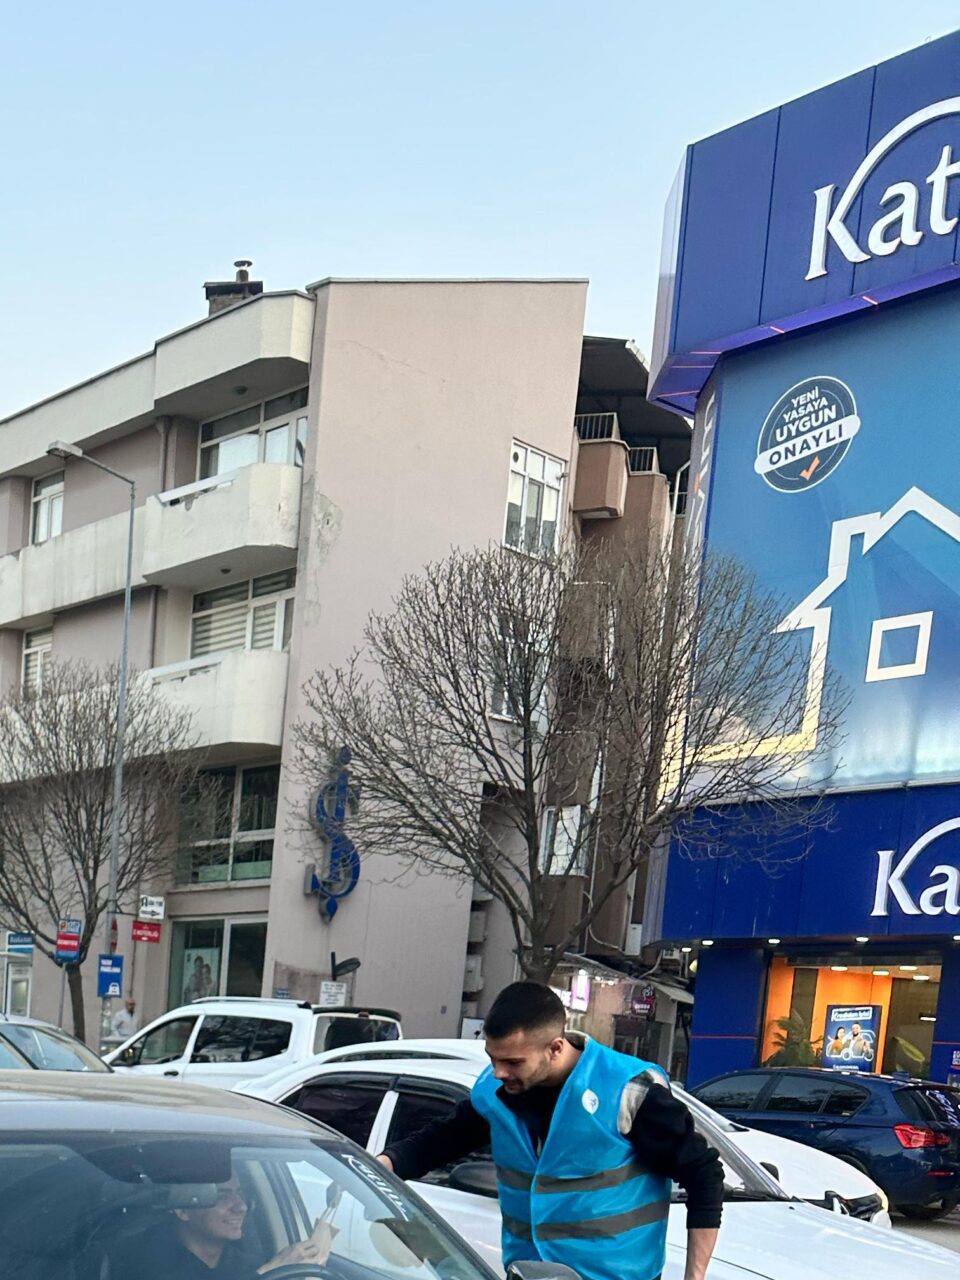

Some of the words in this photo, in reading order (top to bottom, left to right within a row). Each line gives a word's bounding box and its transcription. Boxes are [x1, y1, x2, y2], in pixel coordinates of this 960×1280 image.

[783, 397, 828, 422] YASAYA
[791, 386, 819, 408] YENİ
[775, 404, 837, 442] UYGUN
[769, 423, 843, 465] ONAYLI
